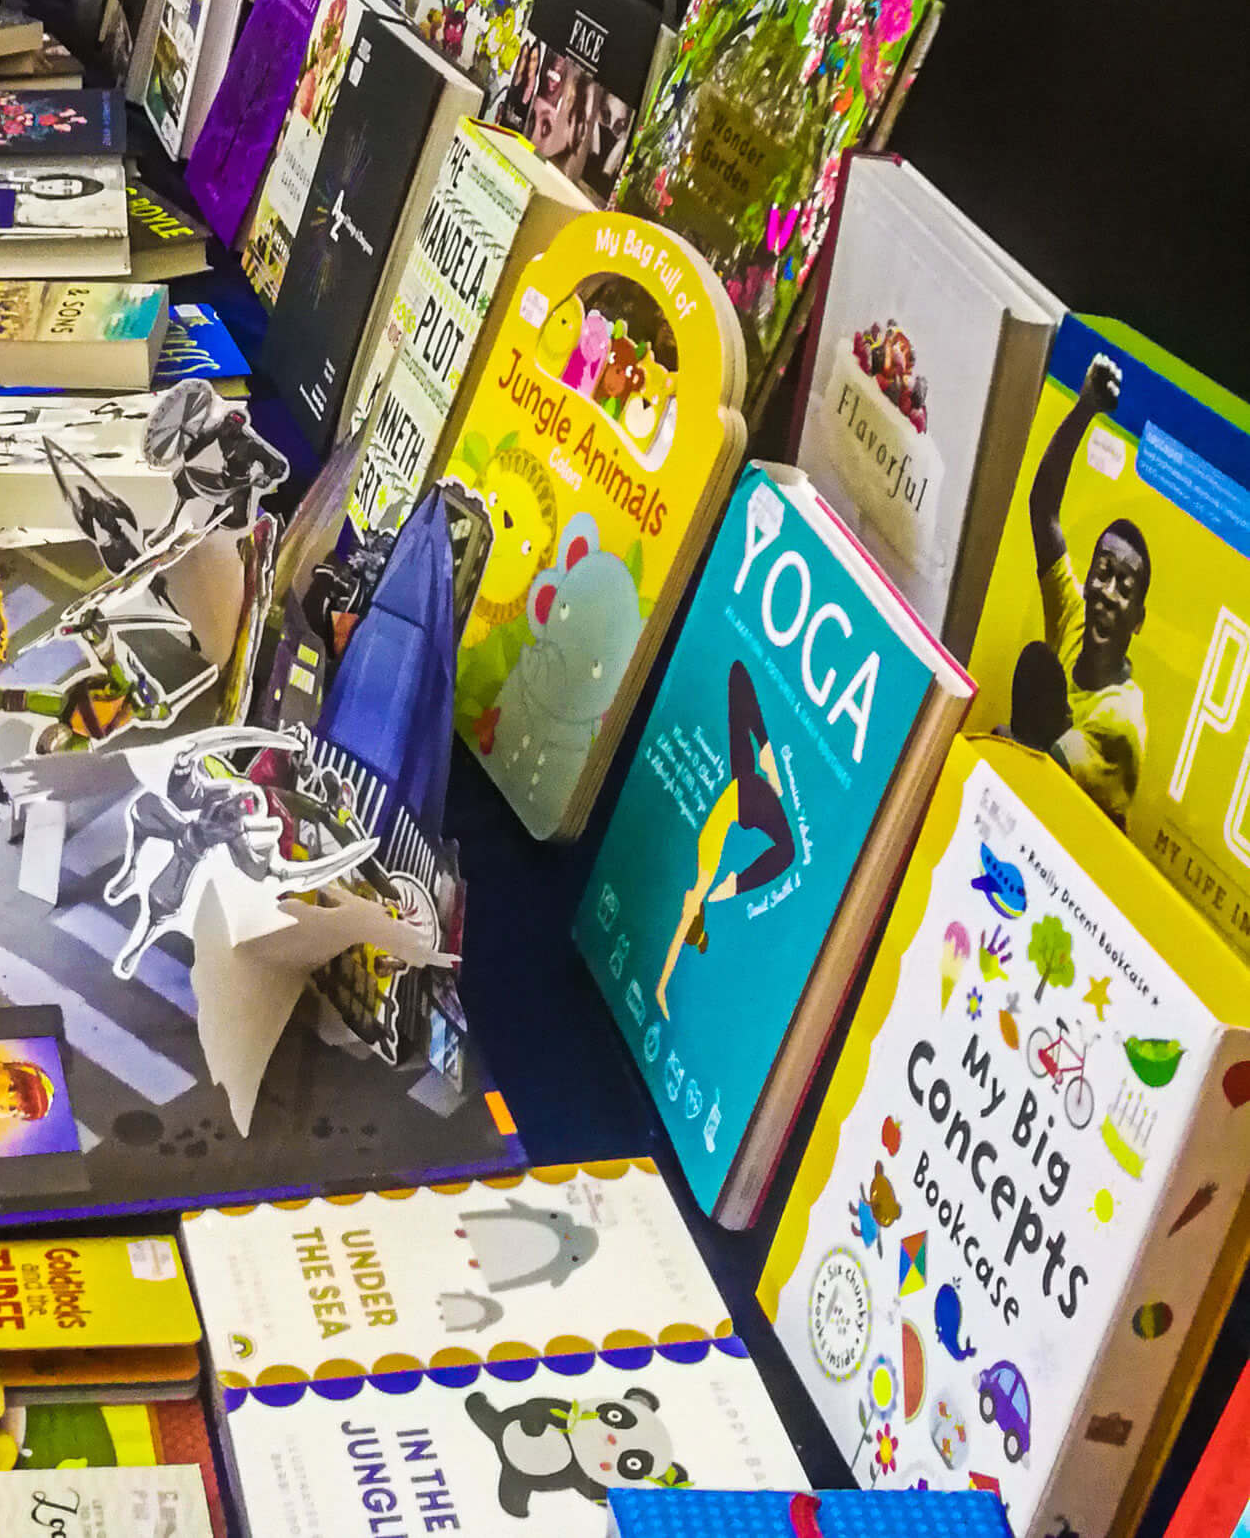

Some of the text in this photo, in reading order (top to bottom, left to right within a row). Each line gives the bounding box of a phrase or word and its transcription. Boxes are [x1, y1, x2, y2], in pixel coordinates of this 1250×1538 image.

[569, 20, 605, 63] FACE
[448, 133, 471, 191] THE
[701, 139, 750, 197] Garden
[711, 110, 766, 167] Wonder
[420, 202, 490, 312] MANDELA
[595, 227, 698, 320] My Bag Full of
[51, 287, 91, 335] & SONS
[414, 294, 465, 384] PLOT
[365, 371, 426, 482] KNNETH
[498, 348, 573, 445] Jungle
[574, 422, 669, 537] Animals
[548, 446, 583, 492] Colors
[836, 382, 929, 513] Flavorful
[733, 481, 882, 763] YOGA
[1153, 828, 1184, 859] MY
[1183, 857, 1229, 913] LIFE
[1028, 849, 1150, 997] Really Decent Bookcase
[960, 1032, 1071, 1207] My Big
[906, 1039, 1089, 1319] Concepts
[21, 1262, 50, 1317] and the
[44, 1247, 93, 1330] Goldilocks
[291, 1227, 352, 1341] THE SEA
[341, 1228, 399, 1329] UNDER
[912, 1150, 1021, 1328] Bookcase
[340, 1419, 409, 1538] JUNGL
[395, 1428, 462, 1533] IN THE
